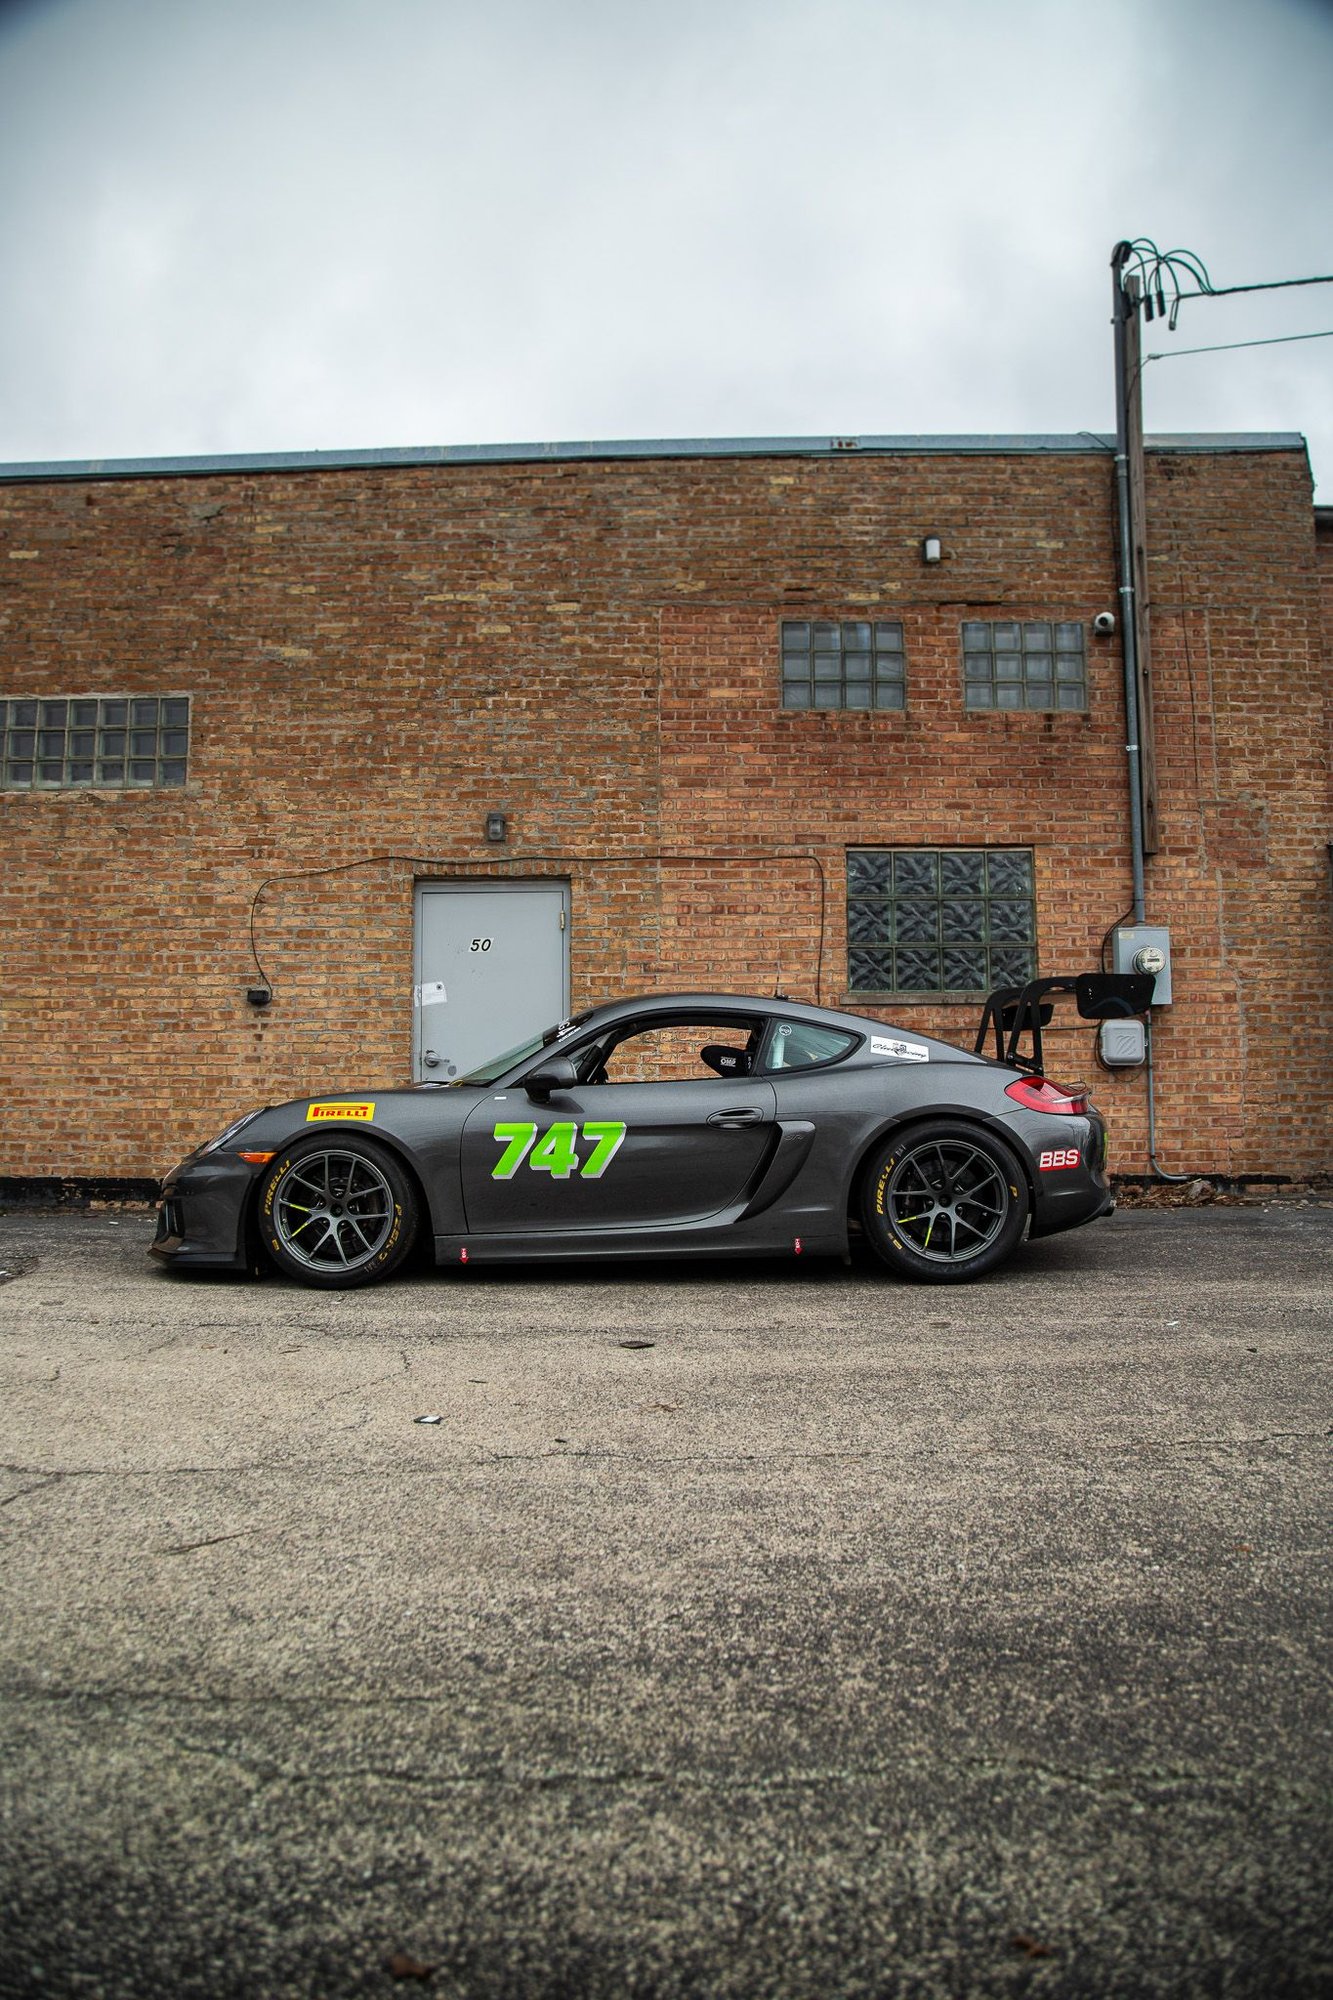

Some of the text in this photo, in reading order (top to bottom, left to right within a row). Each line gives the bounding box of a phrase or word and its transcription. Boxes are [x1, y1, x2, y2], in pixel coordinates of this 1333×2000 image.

[470, 938, 492, 952] 50
[313, 1106, 368, 1118] PIRELLI
[491, 1121, 627, 1180] 747
[1039, 1149, 1080, 1169] BBS
[264, 1159, 291, 1216] PIRELLI
[876, 1157, 895, 1215] PIRELLI
